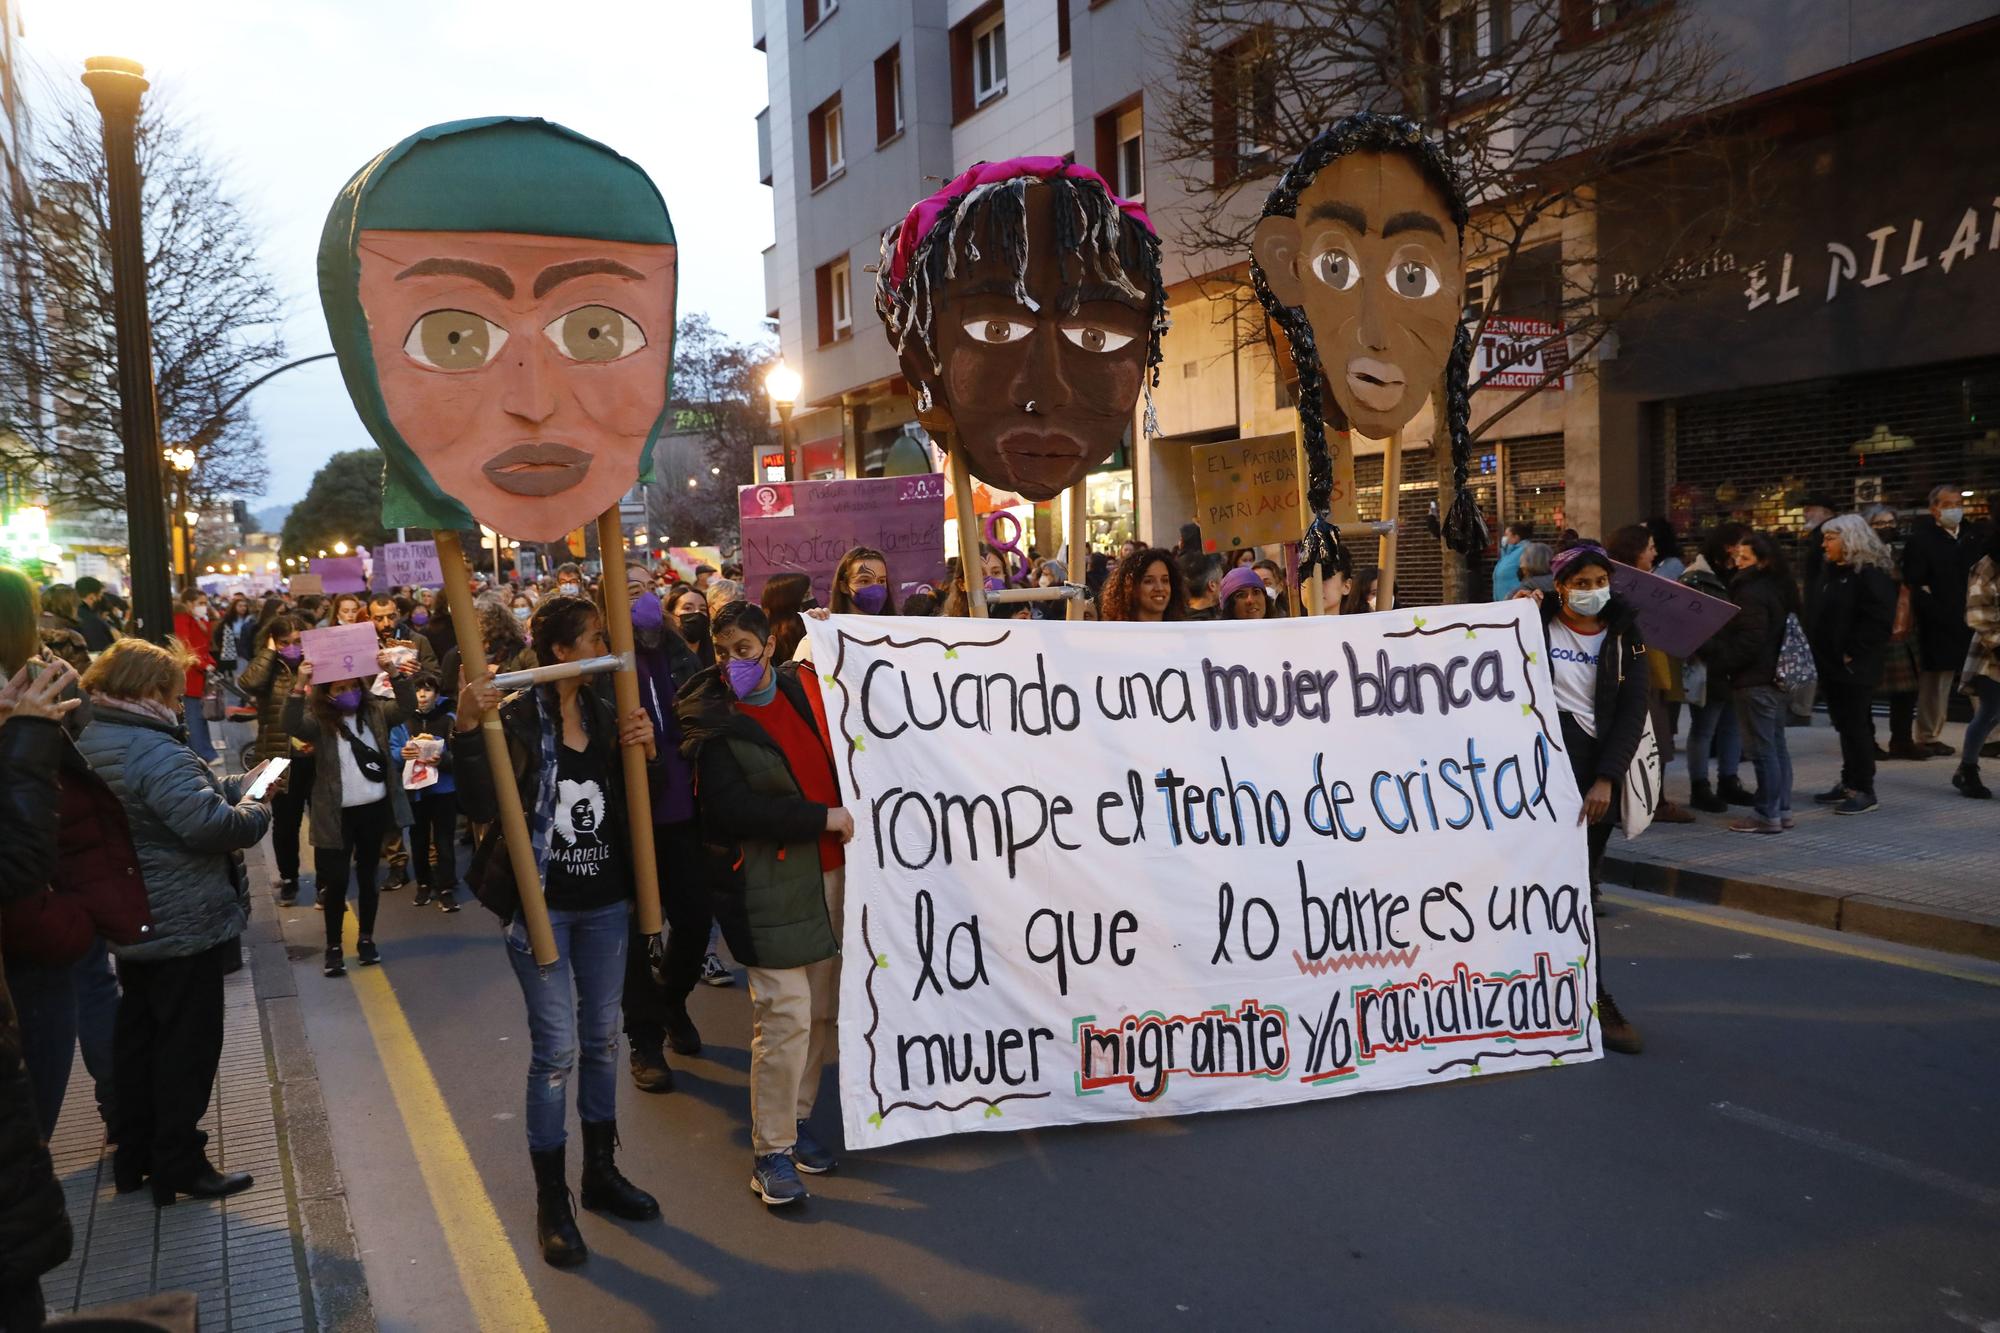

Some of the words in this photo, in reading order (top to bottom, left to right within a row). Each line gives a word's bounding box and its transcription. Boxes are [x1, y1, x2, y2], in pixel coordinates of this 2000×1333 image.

[1743, 252, 1800, 311] EL
[1208, 455, 1233, 473] EL
[1253, 471, 1272, 486] ME
[861, 652, 1080, 740] Cuando
[1096, 668, 1195, 723] una
[1201, 658, 1339, 732] mujer
[1342, 641, 1514, 718] blanca
[871, 784, 1081, 879] rompe
[1097, 769, 1146, 845] el
[1155, 756, 1291, 847] techo
[1303, 752, 1367, 842] de
[1370, 731, 1557, 834] cristal
[548, 844, 609, 862] MARIELLE
[912, 889, 990, 1001] la
[1025, 908, 1138, 996] que
[1211, 882, 1280, 965] lo
[1297, 859, 1410, 960] barre
[1420, 881, 1475, 943] es
[1488, 883, 1589, 945] una
[897, 1027, 1054, 1091] mujer
[1084, 1004, 1285, 1097] migrante
[1361, 955, 1577, 1054] racializada
